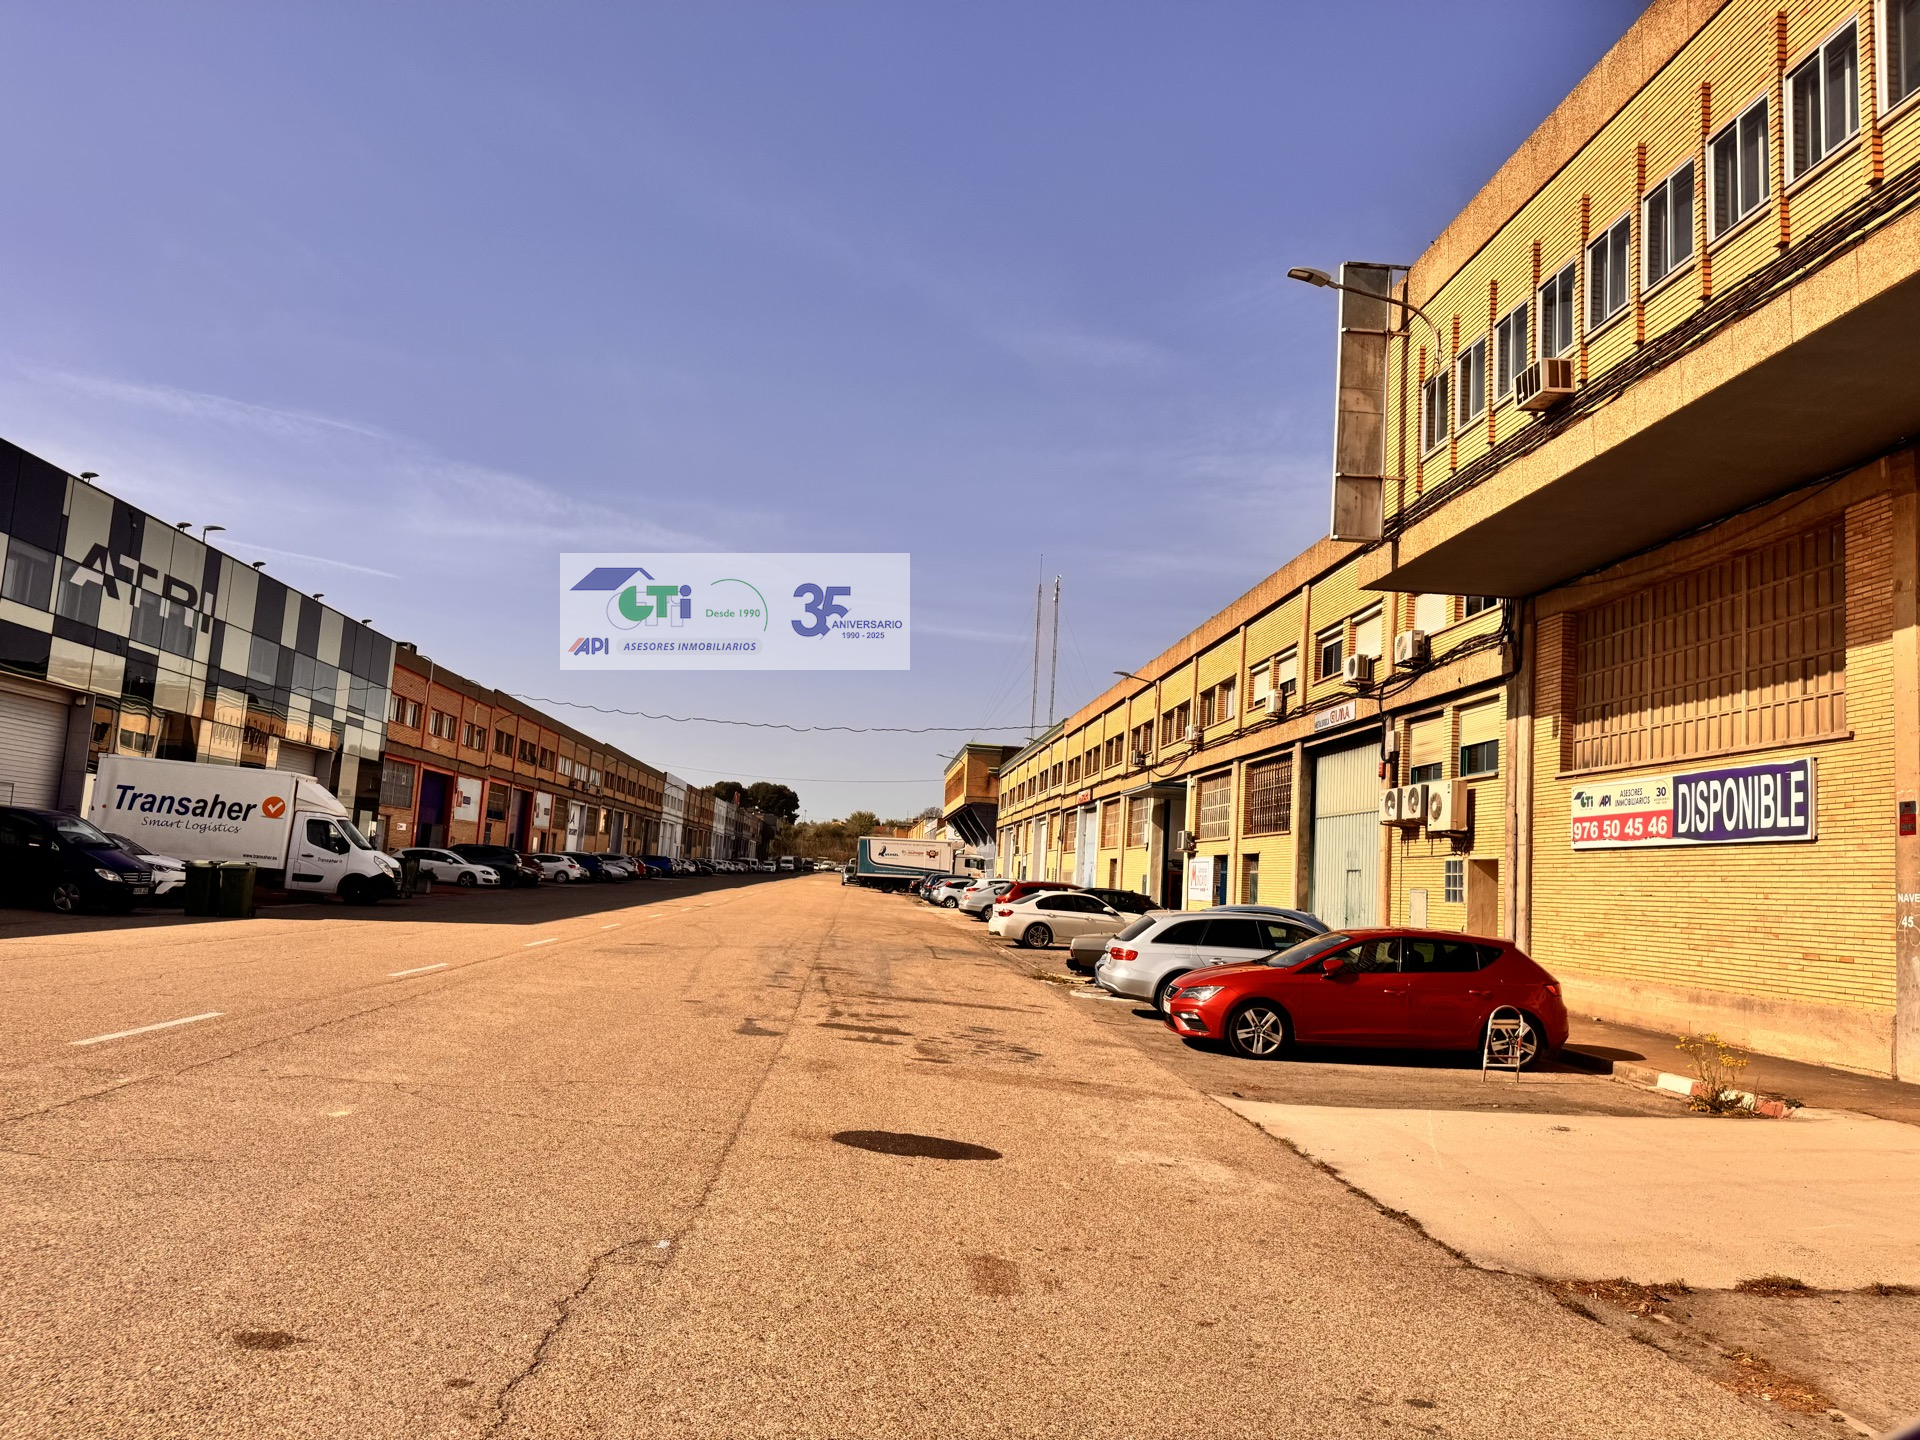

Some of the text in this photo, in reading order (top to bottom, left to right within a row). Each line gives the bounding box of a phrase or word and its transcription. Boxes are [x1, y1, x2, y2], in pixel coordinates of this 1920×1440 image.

[70, 543, 214, 634] ATRI
[1620, 788, 1643, 798] ASESORES
[1656, 787, 1667, 797] 30
[115, 784, 257, 822] Transaher
[1599, 795, 1612, 808] API
[1615, 796, 1651, 807] INMOBILIARIOS
[1677, 770, 1805, 834] DISPONIBLE
[141, 816, 242, 834] Smart Logistics
[1573, 815, 1668, 839] 976 50 45 46
[1897, 893, 1920, 903] NAVE
[1901, 915, 1914, 928] 45
